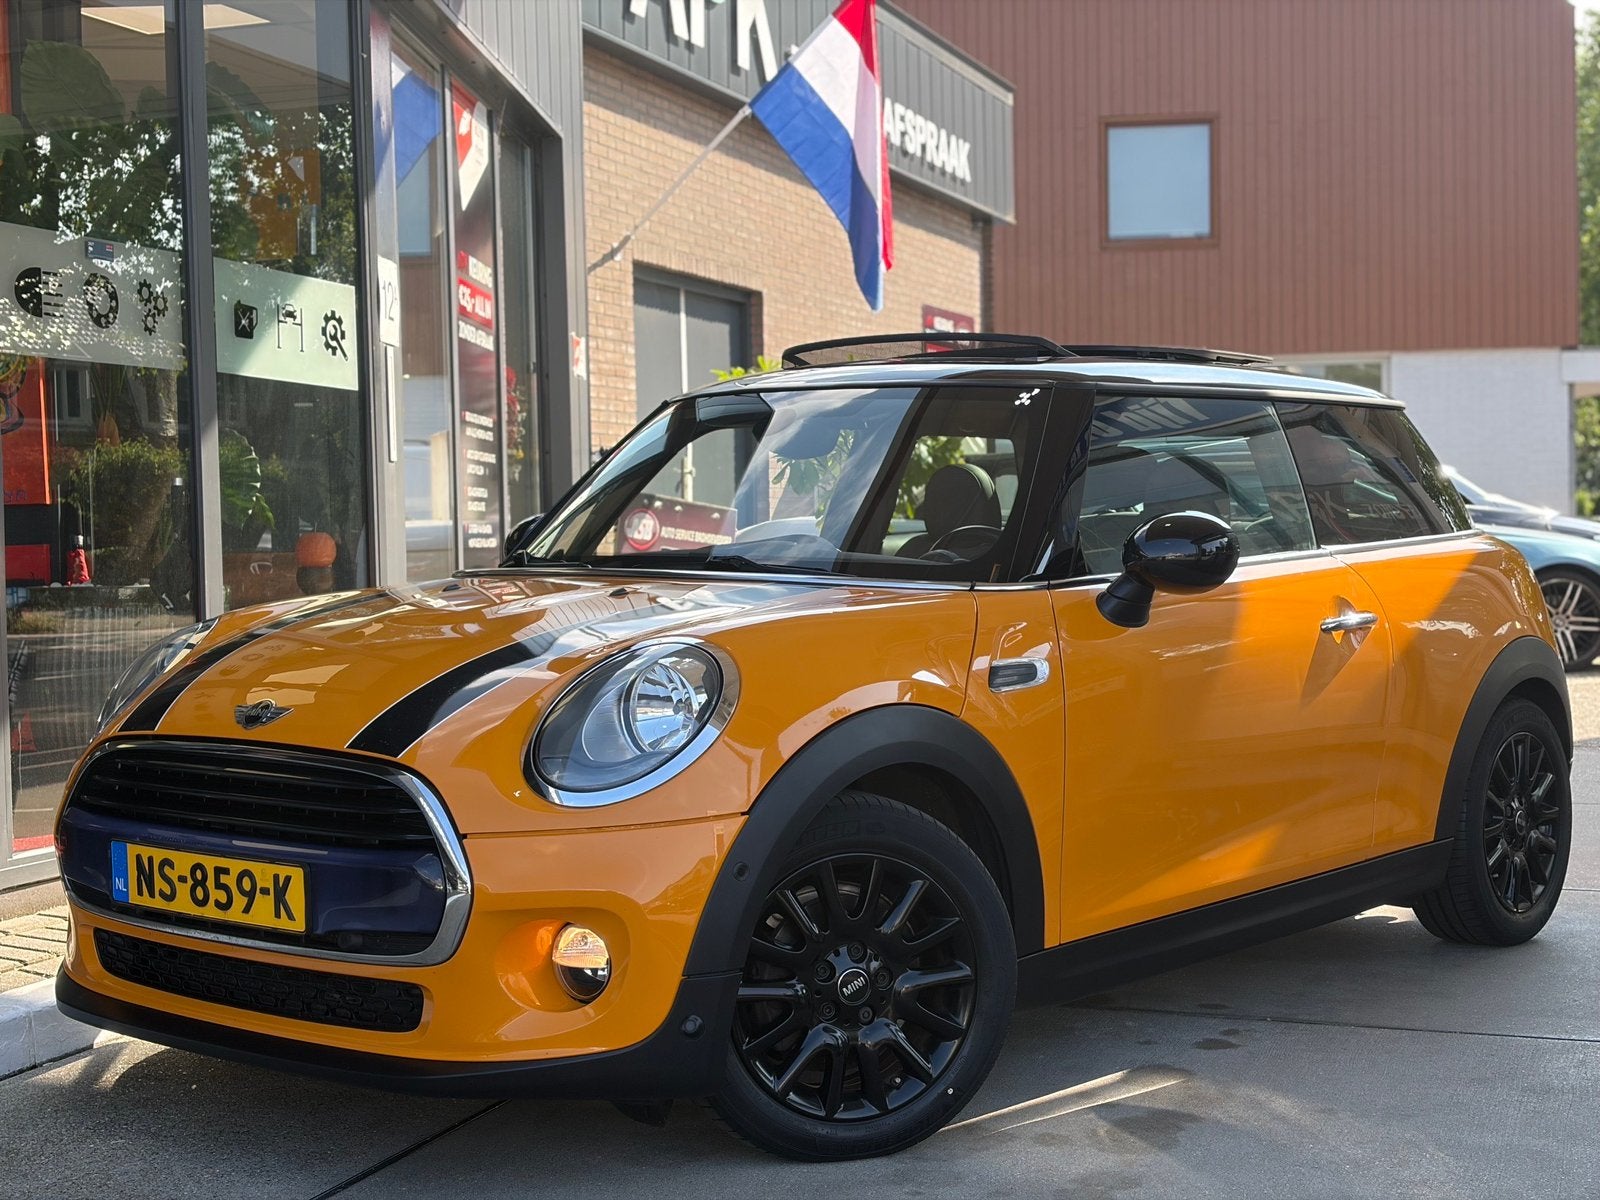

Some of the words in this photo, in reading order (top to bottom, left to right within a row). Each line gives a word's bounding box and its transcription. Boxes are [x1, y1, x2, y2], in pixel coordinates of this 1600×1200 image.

[883, 97, 971, 182] AFSPRAAK
[115, 876, 127, 892] NL
[135, 853, 297, 922] NS-859-K
[842, 976, 866, 997] MINI
